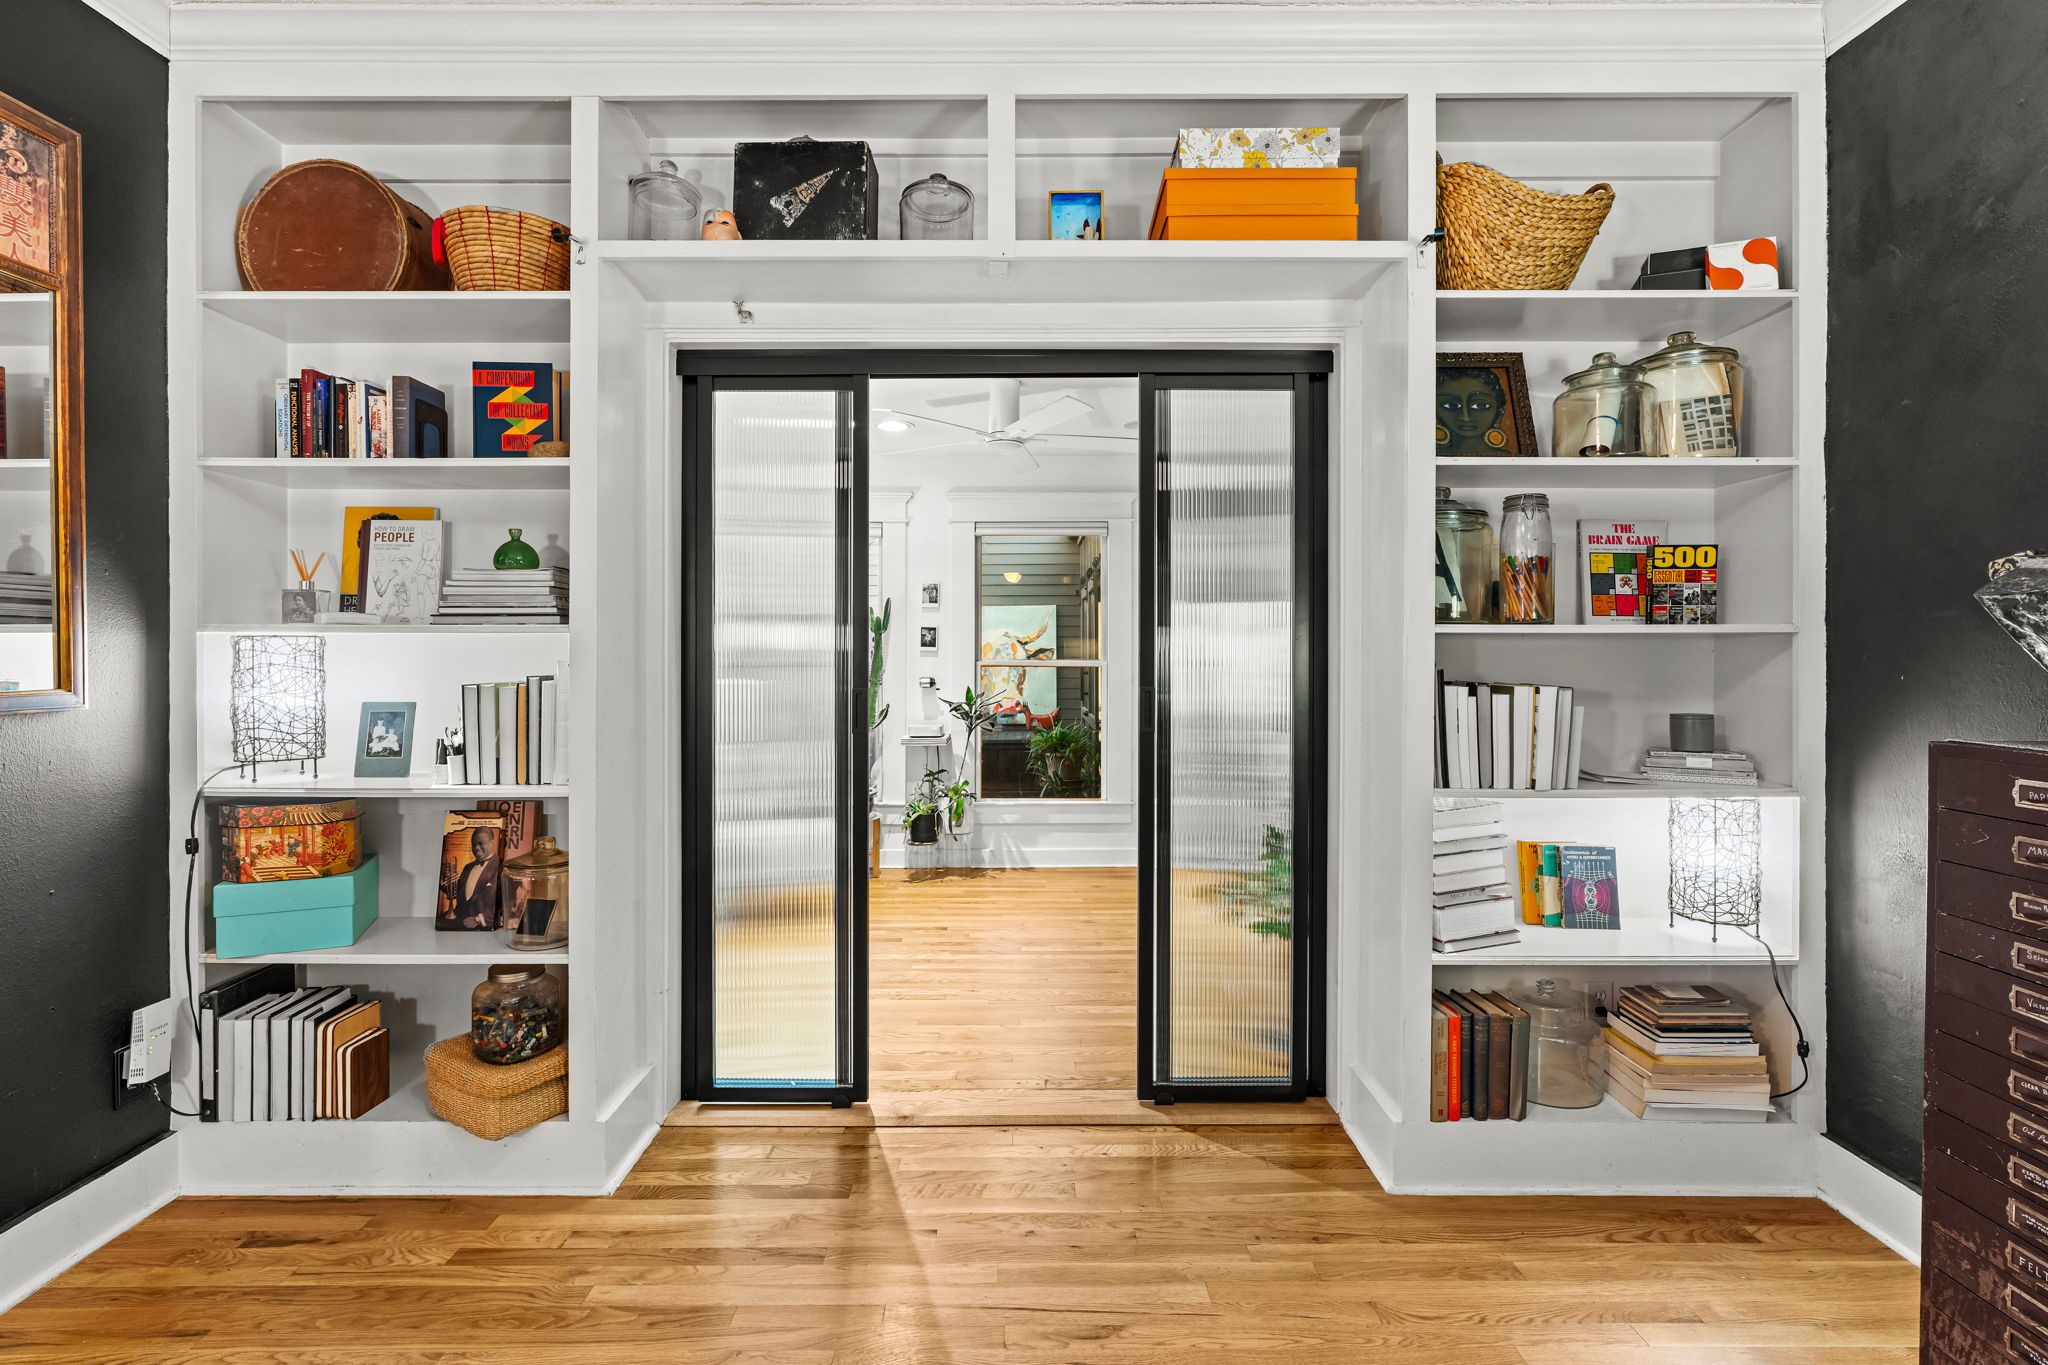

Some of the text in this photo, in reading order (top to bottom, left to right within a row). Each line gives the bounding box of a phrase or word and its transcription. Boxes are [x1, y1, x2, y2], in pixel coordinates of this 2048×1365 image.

[478, 371, 530, 385] A COMPENDIUM
[492, 404, 544, 418] OF COLLECTIVE
[507, 436, 528, 449] NOUNS
[1612, 524, 1635, 533] THE
[374, 532, 415, 542] PEOPLE
[1588, 535, 1660, 545] BRAIN GAME
[1654, 546, 1716, 567] 500
[1654, 570, 1684, 583] ESSENTIAL
[2029, 791, 2048, 801] PAP
[150, 1023, 169, 1032] NETGEAR
[2019, 1256, 2048, 1282] FELT
